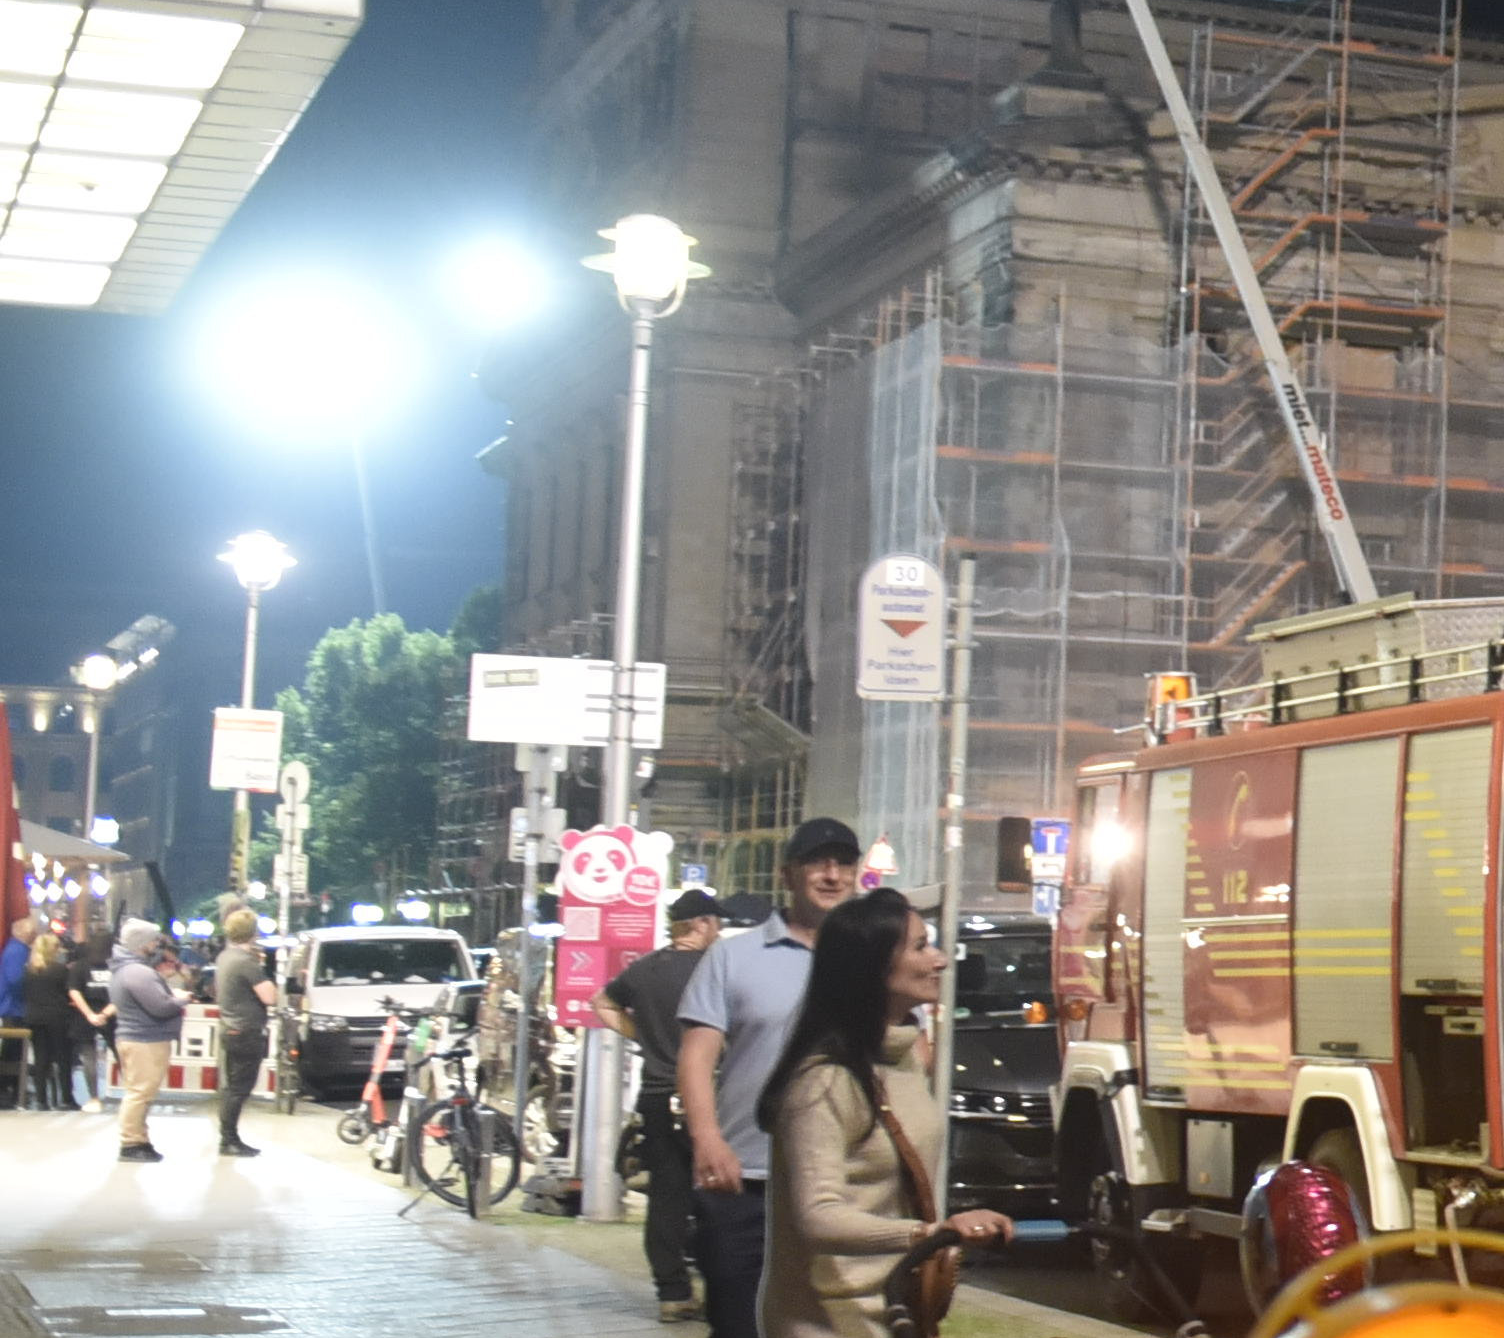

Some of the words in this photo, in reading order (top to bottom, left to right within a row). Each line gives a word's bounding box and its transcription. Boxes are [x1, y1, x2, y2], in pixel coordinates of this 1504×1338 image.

[1306, 445, 1345, 521] mateco
[894, 565, 918, 582] 30
[1222, 869, 1248, 904] 112
